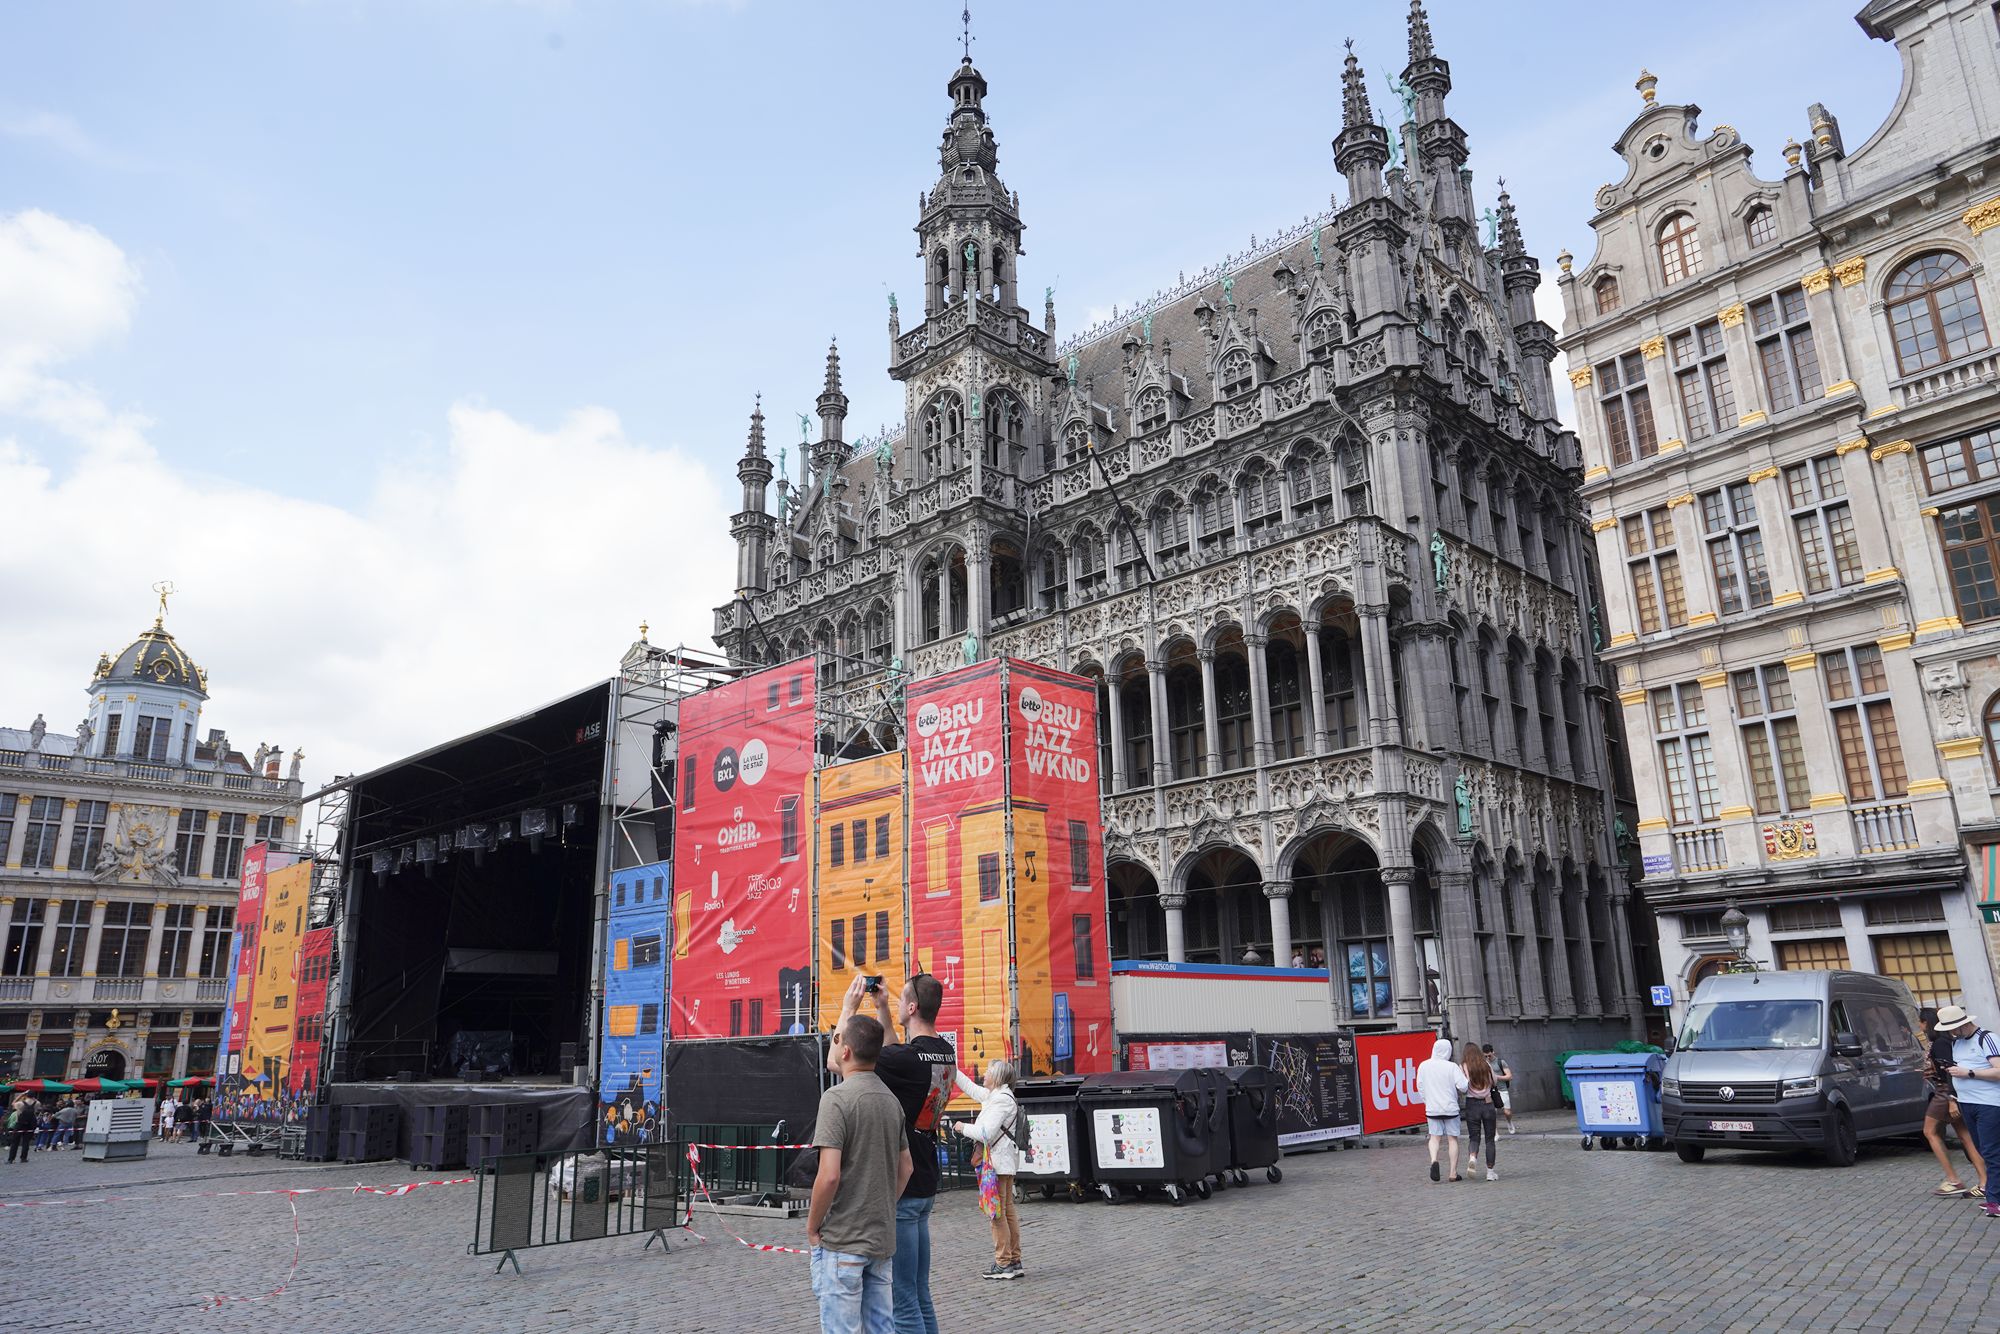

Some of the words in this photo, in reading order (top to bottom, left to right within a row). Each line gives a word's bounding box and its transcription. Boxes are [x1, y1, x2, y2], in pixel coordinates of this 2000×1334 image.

[939, 697, 983, 732] BRU
[1041, 699, 1081, 731] BRU
[920, 727, 971, 763] JAZZ
[1024, 722, 1072, 754] JAZZ
[743, 756, 750, 764] LA
[750, 753, 764, 762] VILLE
[743, 763, 750, 771] DE
[750, 760, 763, 769] STAD
[1025, 747, 1090, 783] WKND
[717, 767, 735, 782] BXL
[921, 750, 995, 788] WKND
[747, 877, 782, 893] MUSIQ3
[746, 891, 763, 900] JAZZ
[716, 972, 724, 980] LES
[918, 1052, 945, 1062] VINCENT
